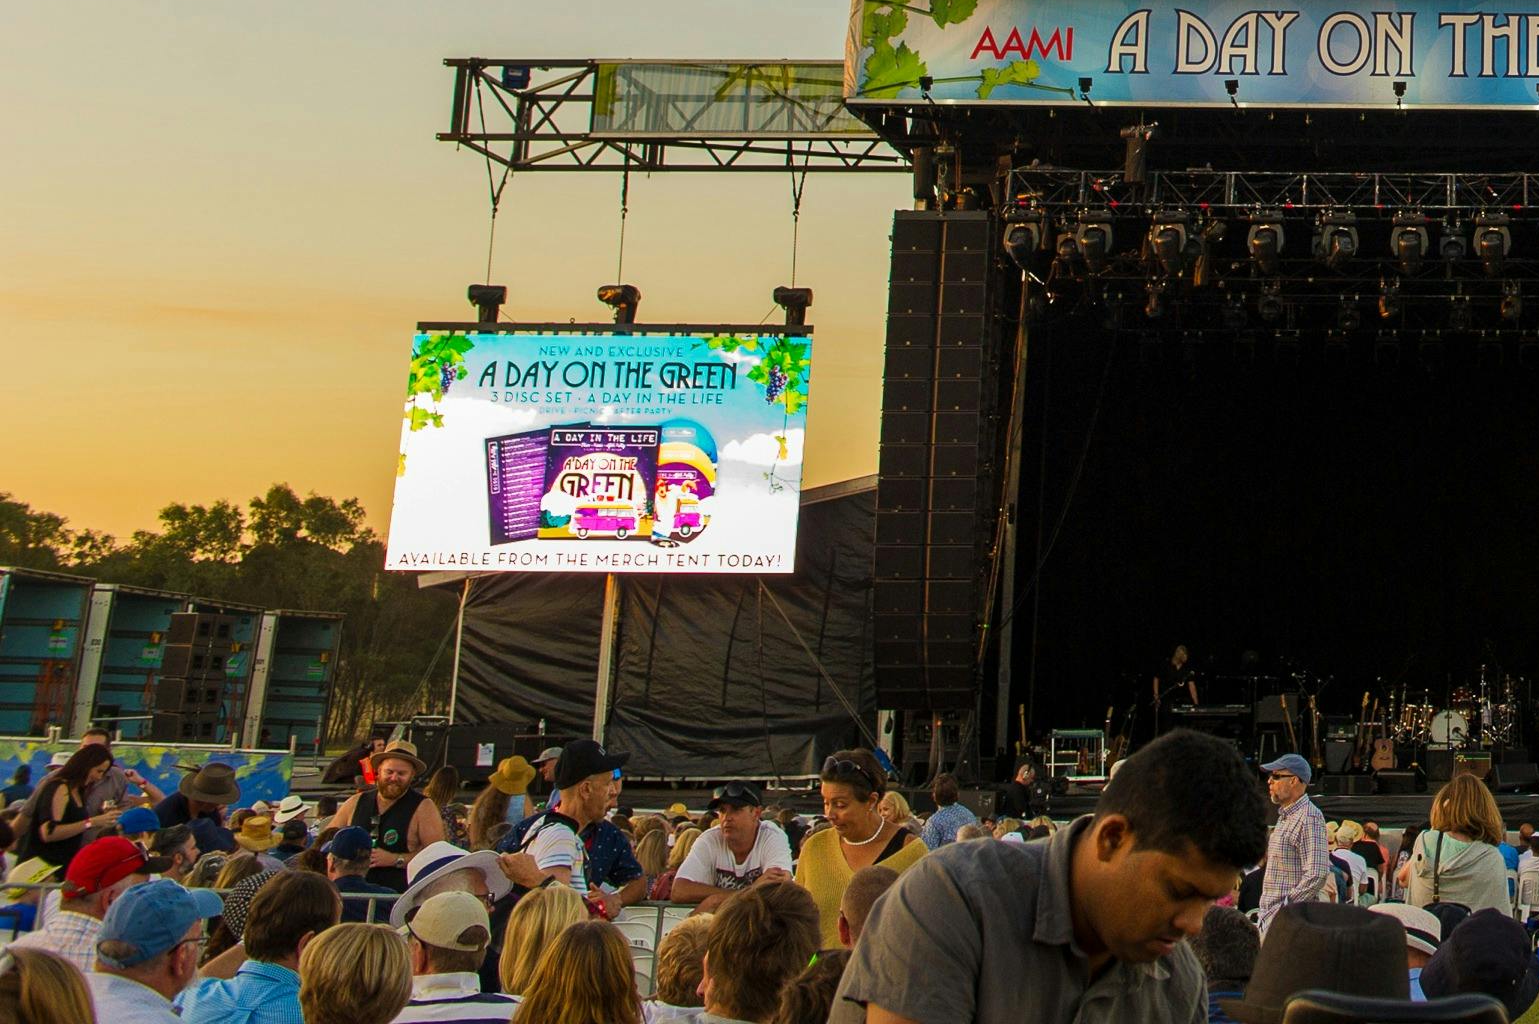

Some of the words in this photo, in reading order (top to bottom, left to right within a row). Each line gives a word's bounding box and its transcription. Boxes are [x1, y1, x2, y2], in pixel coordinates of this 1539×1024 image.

[970, 25, 1074, 61] AAMI
[1102, 8, 1153, 75] A
[1172, 8, 1300, 76] DAY
[1317, 10, 1417, 77] ON
[539, 346, 570, 357] NEW
[574, 346, 604, 357] AND
[608, 346, 684, 357] EXCLUSIVE
[479, 360, 497, 388] A
[505, 360, 559, 388] DAY
[562, 361, 606, 388] ON
[615, 361, 654, 389] THE
[659, 361, 737, 390] GREEN
[490, 391, 499, 403] 3
[504, 391, 540, 403] DISC
[545, 392, 572, 403] SET
[588, 392, 596, 404] A
[602, 392, 632, 404] DAY
[636, 393, 652, 404] IN
[658, 393, 686, 404] THE
[692, 393, 724, 405] LIFE
[553, 433, 561, 442] A
[565, 433, 584, 442] DAY
[590, 433, 602, 442] IN
[608, 433, 626, 443] THE
[631, 433, 655, 444] LIFE
[599, 457, 616, 470] ON
[619, 457, 638, 471] THE
[560, 472, 635, 501] GREEN
[399, 552, 491, 566] AVAILABLE
[498, 552, 548, 566] FROM
[556, 553, 589, 566] THE
[595, 553, 659, 566] MERCH
[666, 553, 710, 567] TENT
[717, 554, 782, 568] TODAY!
